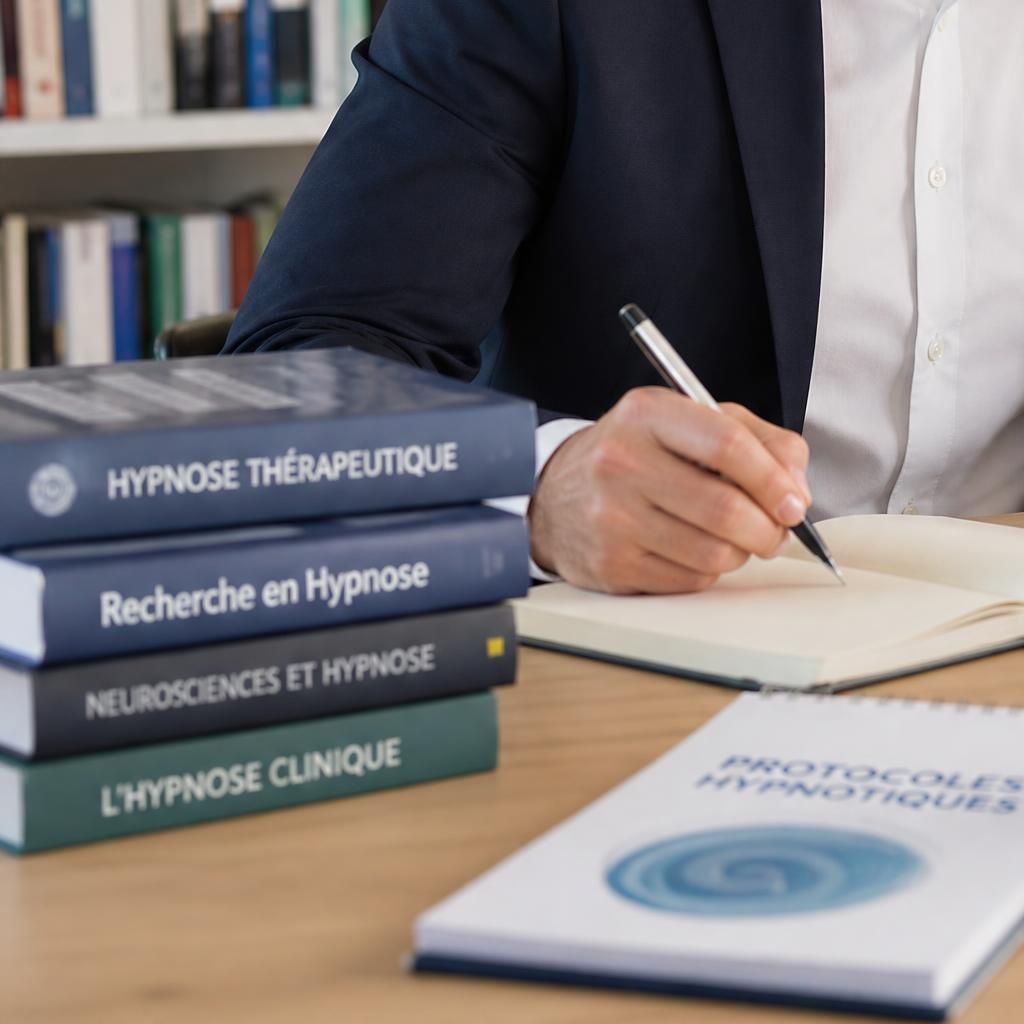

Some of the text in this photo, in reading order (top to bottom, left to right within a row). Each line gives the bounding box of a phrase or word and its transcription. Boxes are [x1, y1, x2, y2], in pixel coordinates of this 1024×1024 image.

[108, 442, 458, 499] HYPNOSE THÉRAPEUTIQUE
[101, 561, 430, 627] Recherche en Hypnose
[86, 644, 436, 719] NEUROSCIENCES ET HYPNOSE
[102, 737, 402, 817] L'HYPNOSE CLINIQUE
[694, 774, 1020, 815] HYPNOTIQUES
[720, 755, 1024, 793] PROTOCOLES
